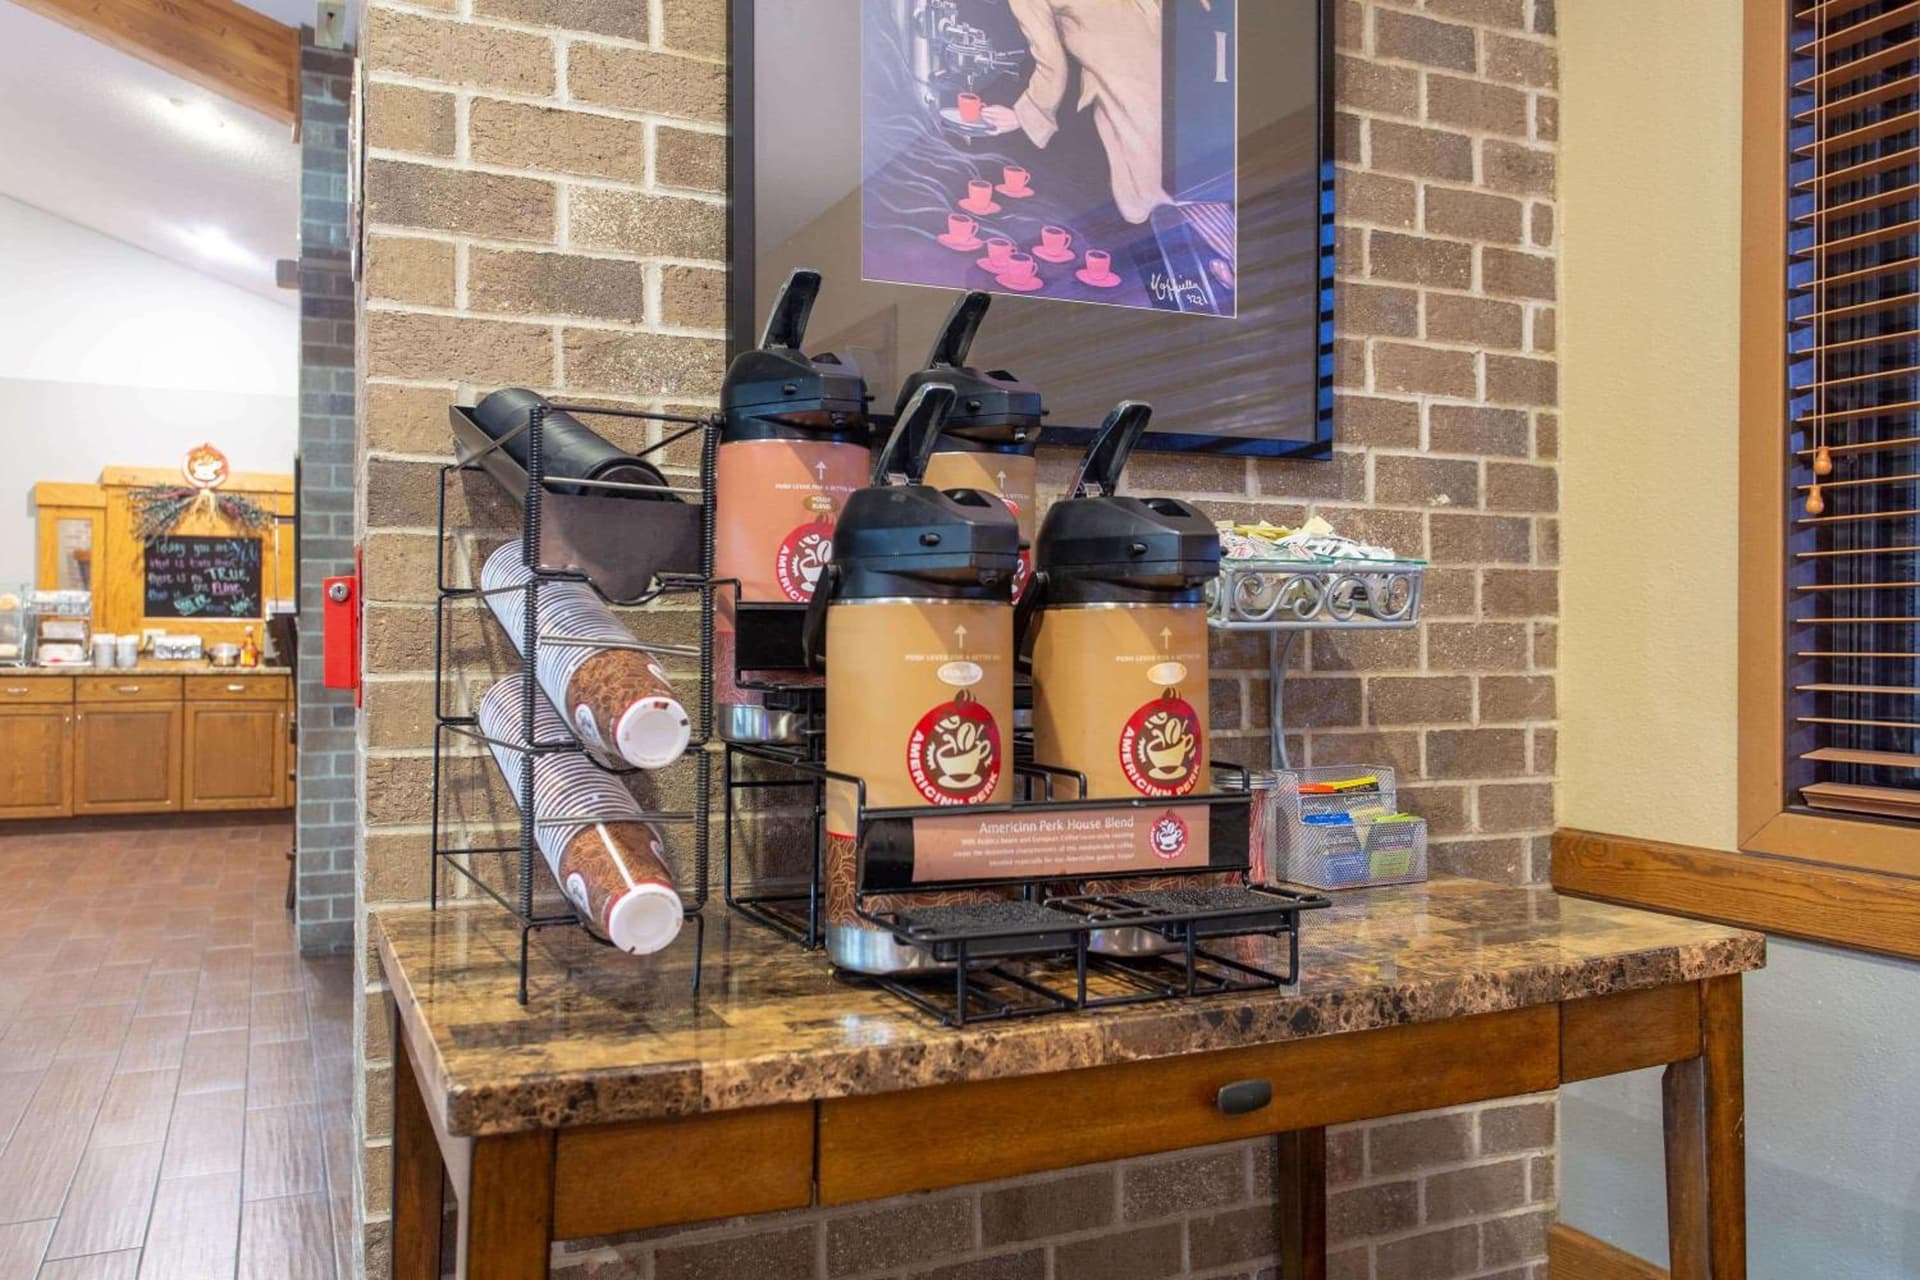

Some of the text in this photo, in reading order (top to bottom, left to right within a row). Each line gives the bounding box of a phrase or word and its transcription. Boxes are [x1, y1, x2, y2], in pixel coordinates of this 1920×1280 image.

[968, 772, 999, 805] PERK
[1176, 764, 1201, 796] PERK
[1039, 818, 1064, 832] Perk
[1067, 818, 1102, 831] House
[1104, 815, 1134, 829] Blend
